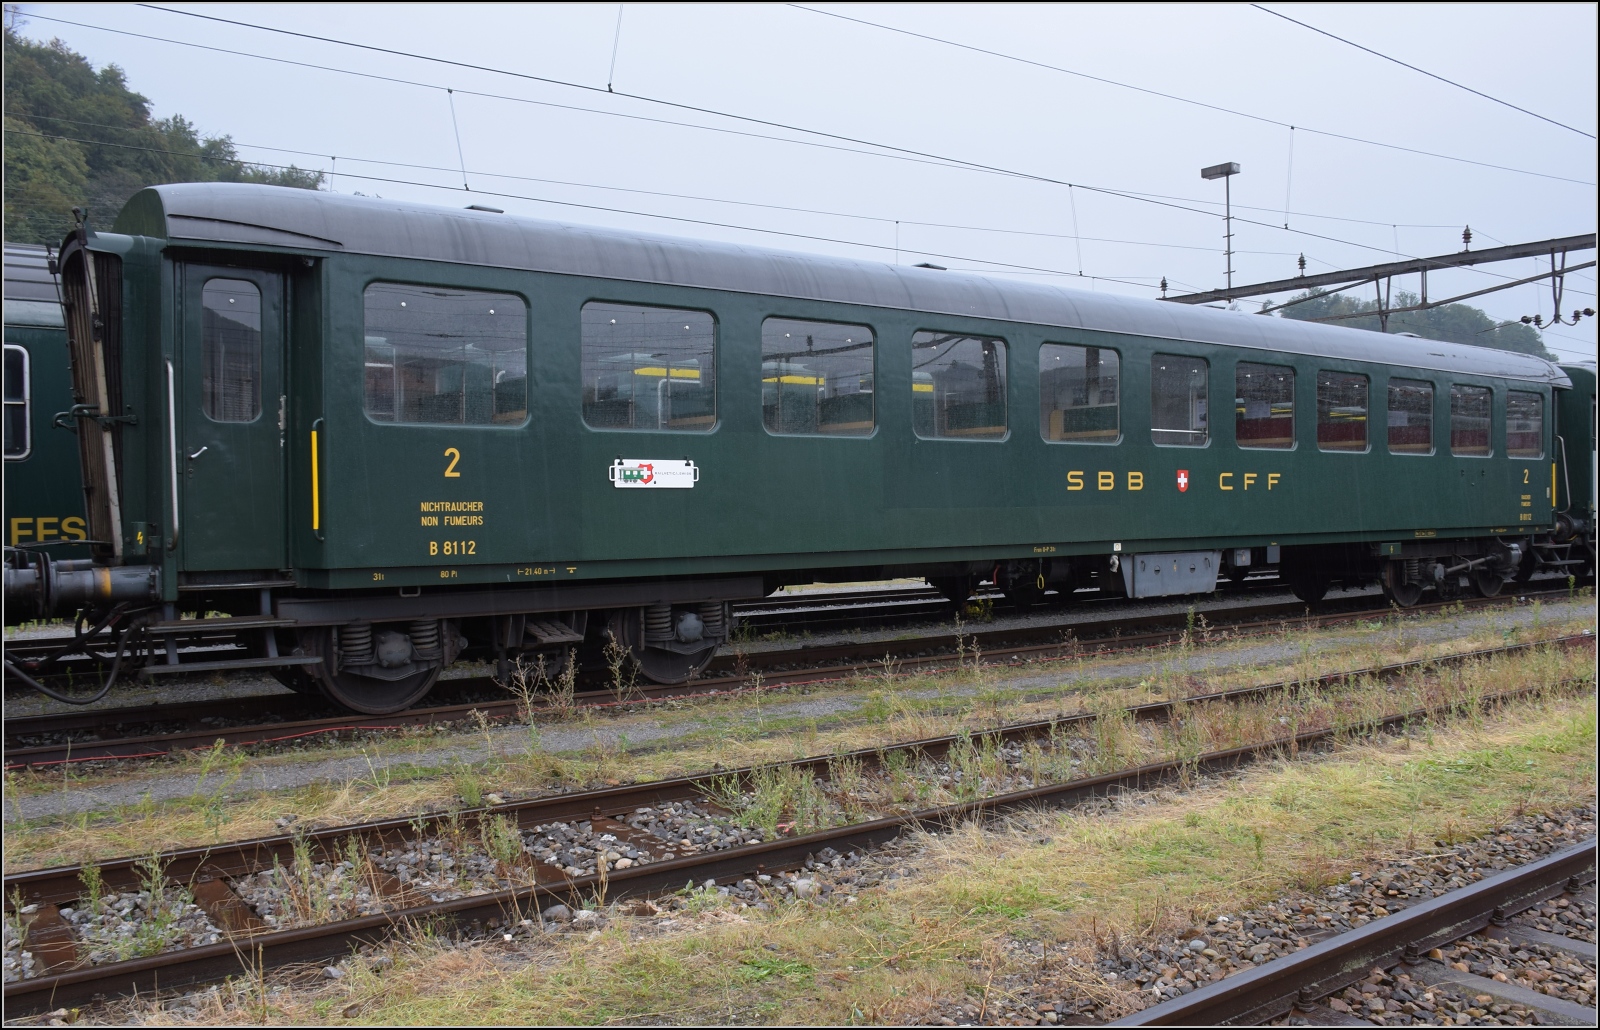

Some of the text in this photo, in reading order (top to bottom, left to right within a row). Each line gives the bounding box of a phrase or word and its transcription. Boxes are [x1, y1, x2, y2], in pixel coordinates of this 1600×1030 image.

[444, 447, 461, 478] 2
[1523, 468, 1529, 484] 2
[420, 501, 484, 512] NICHTRAUCHER
[421, 515, 484, 527] NON FUMEURS
[10, 516, 87, 547] FFS
[429, 540, 476, 556] B 8112
[439, 570, 449, 578] 80
[524, 567, 542, 576] 21.40
